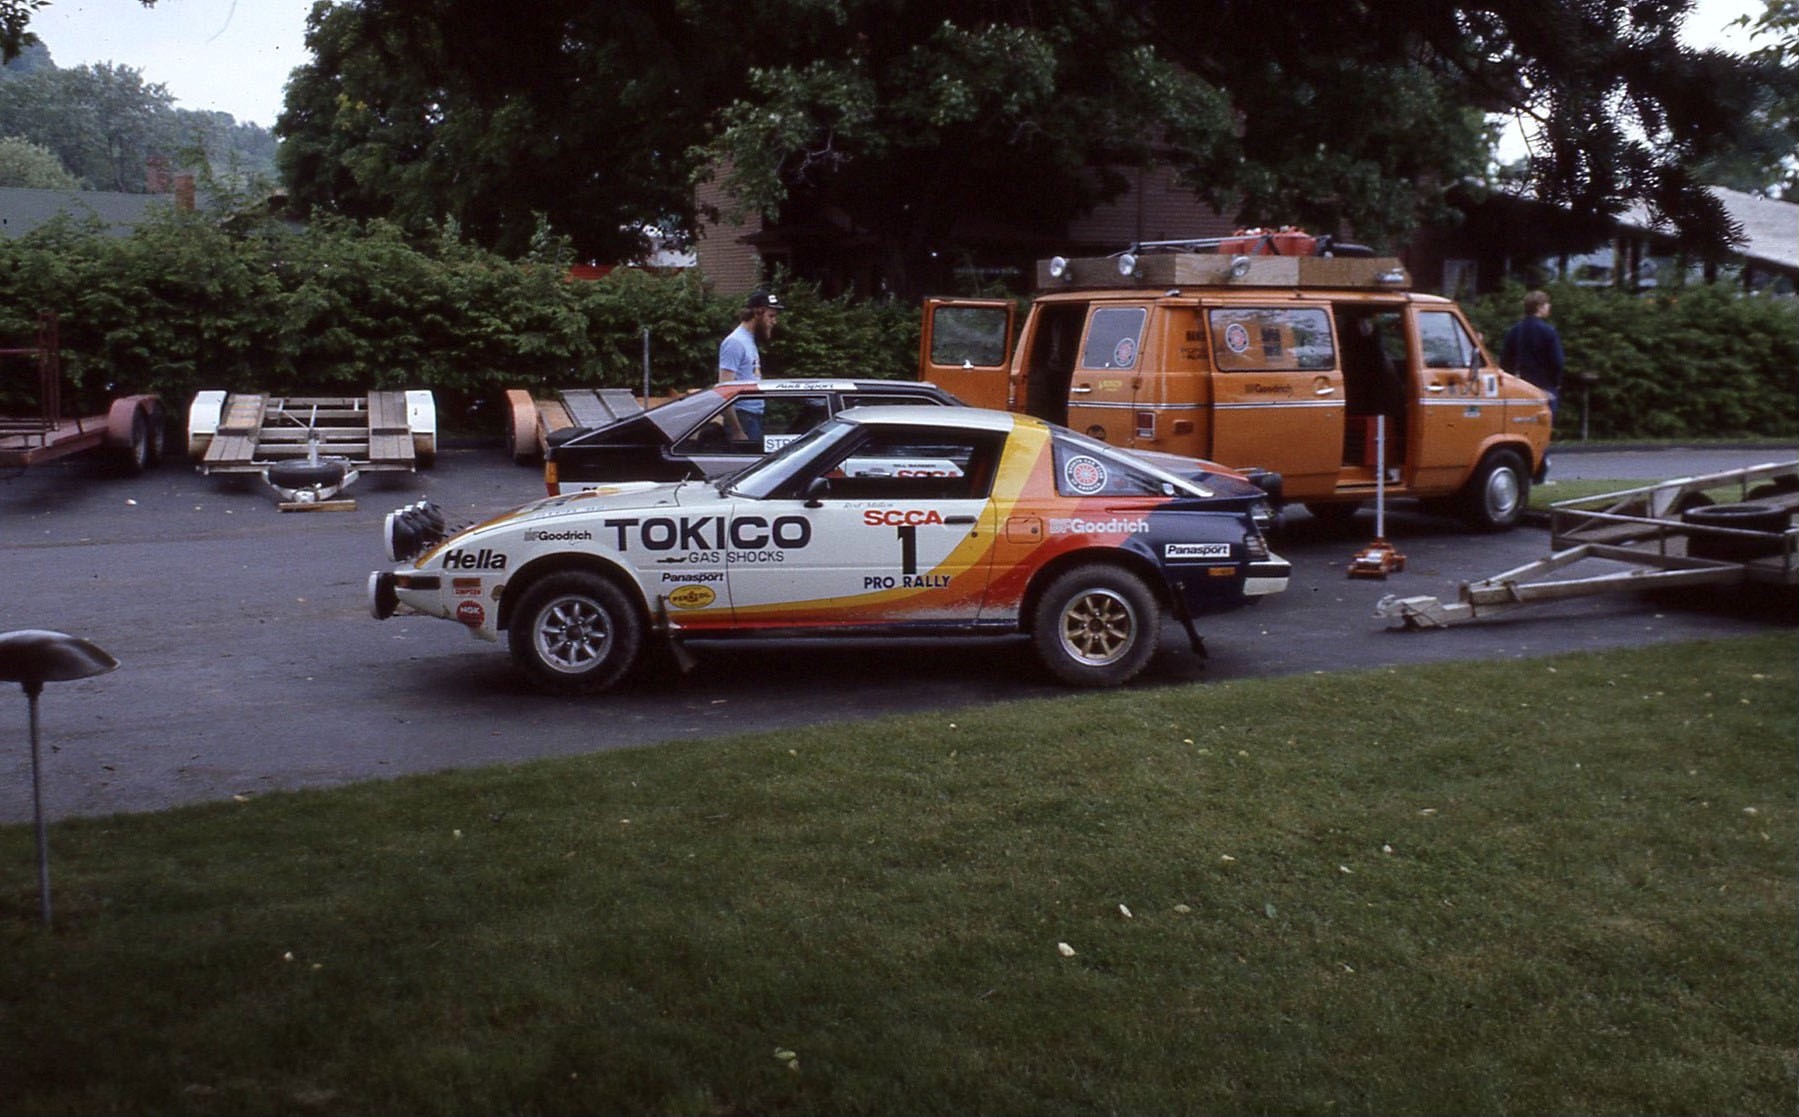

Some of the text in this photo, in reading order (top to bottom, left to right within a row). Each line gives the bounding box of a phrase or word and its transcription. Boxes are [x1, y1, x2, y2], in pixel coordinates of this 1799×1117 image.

[864, 510, 943, 526] SCCA
[1049, 518, 1149, 534] BFGoodrich
[604, 515, 812, 551] TOKICO
[688, 551, 785, 563] GAS SHOCKS
[897, 526, 916, 574] 1
[1167, 545, 1228, 555] Panasport
[442, 549, 507, 569] Hella
[662, 572, 724, 583] Panasport
[864, 575, 950, 589] PRO RALLY
